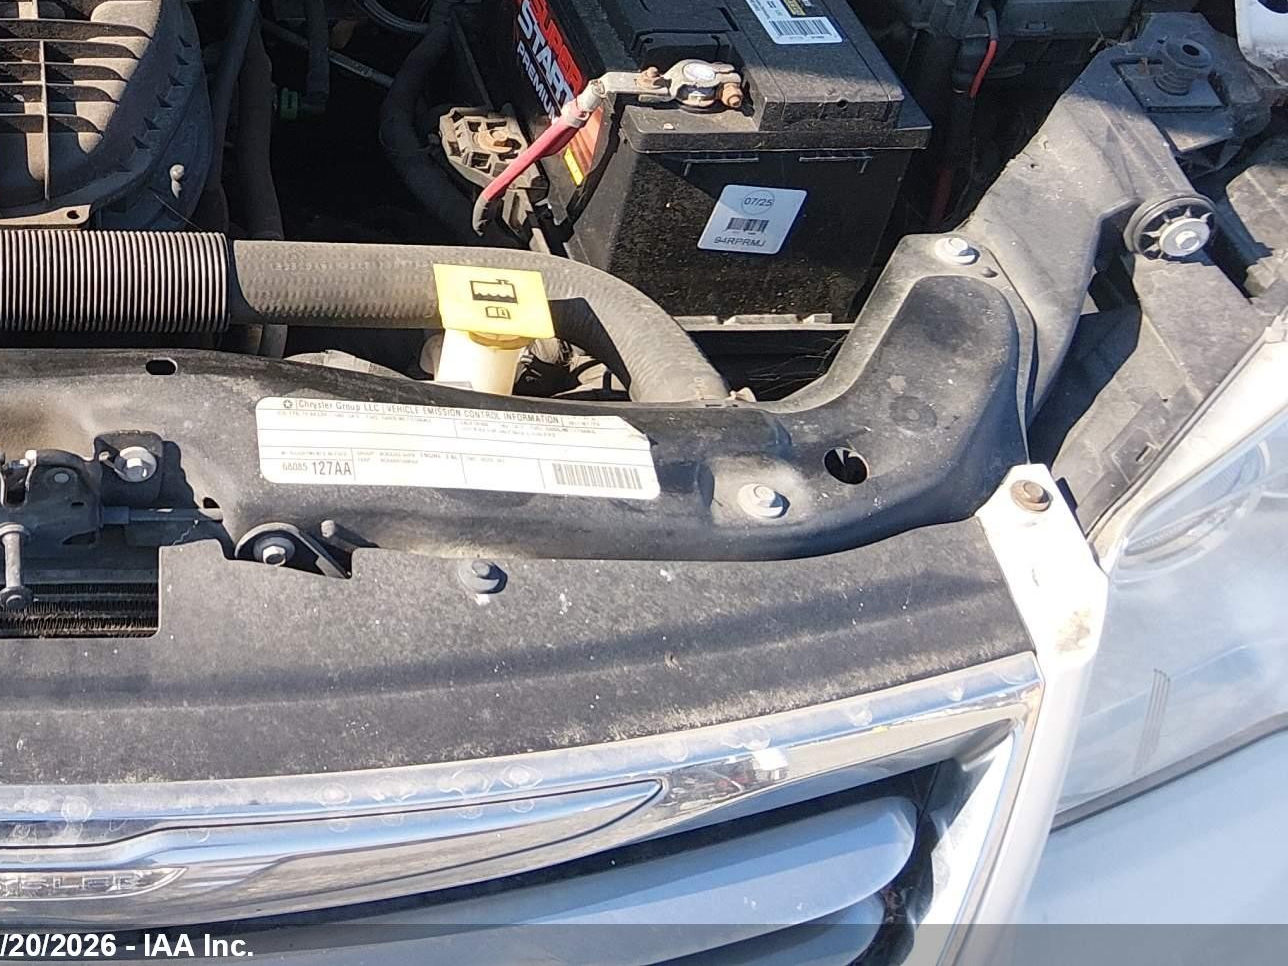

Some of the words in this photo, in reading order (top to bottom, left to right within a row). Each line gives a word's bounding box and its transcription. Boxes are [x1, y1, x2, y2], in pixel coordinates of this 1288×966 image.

[744, 197, 773, 207] 07/25
[298, 399, 333, 410] Chrysler
[335, 401, 361, 412] Group
[363, 403, 380, 413] LLC
[386, 404, 419, 415] VEHICLE
[423, 407, 461, 418] EMISSION
[463, 410, 501, 421] CONTROL
[504, 413, 560, 425] INFORMATION
[312, 460, 352, 476] 127AA
